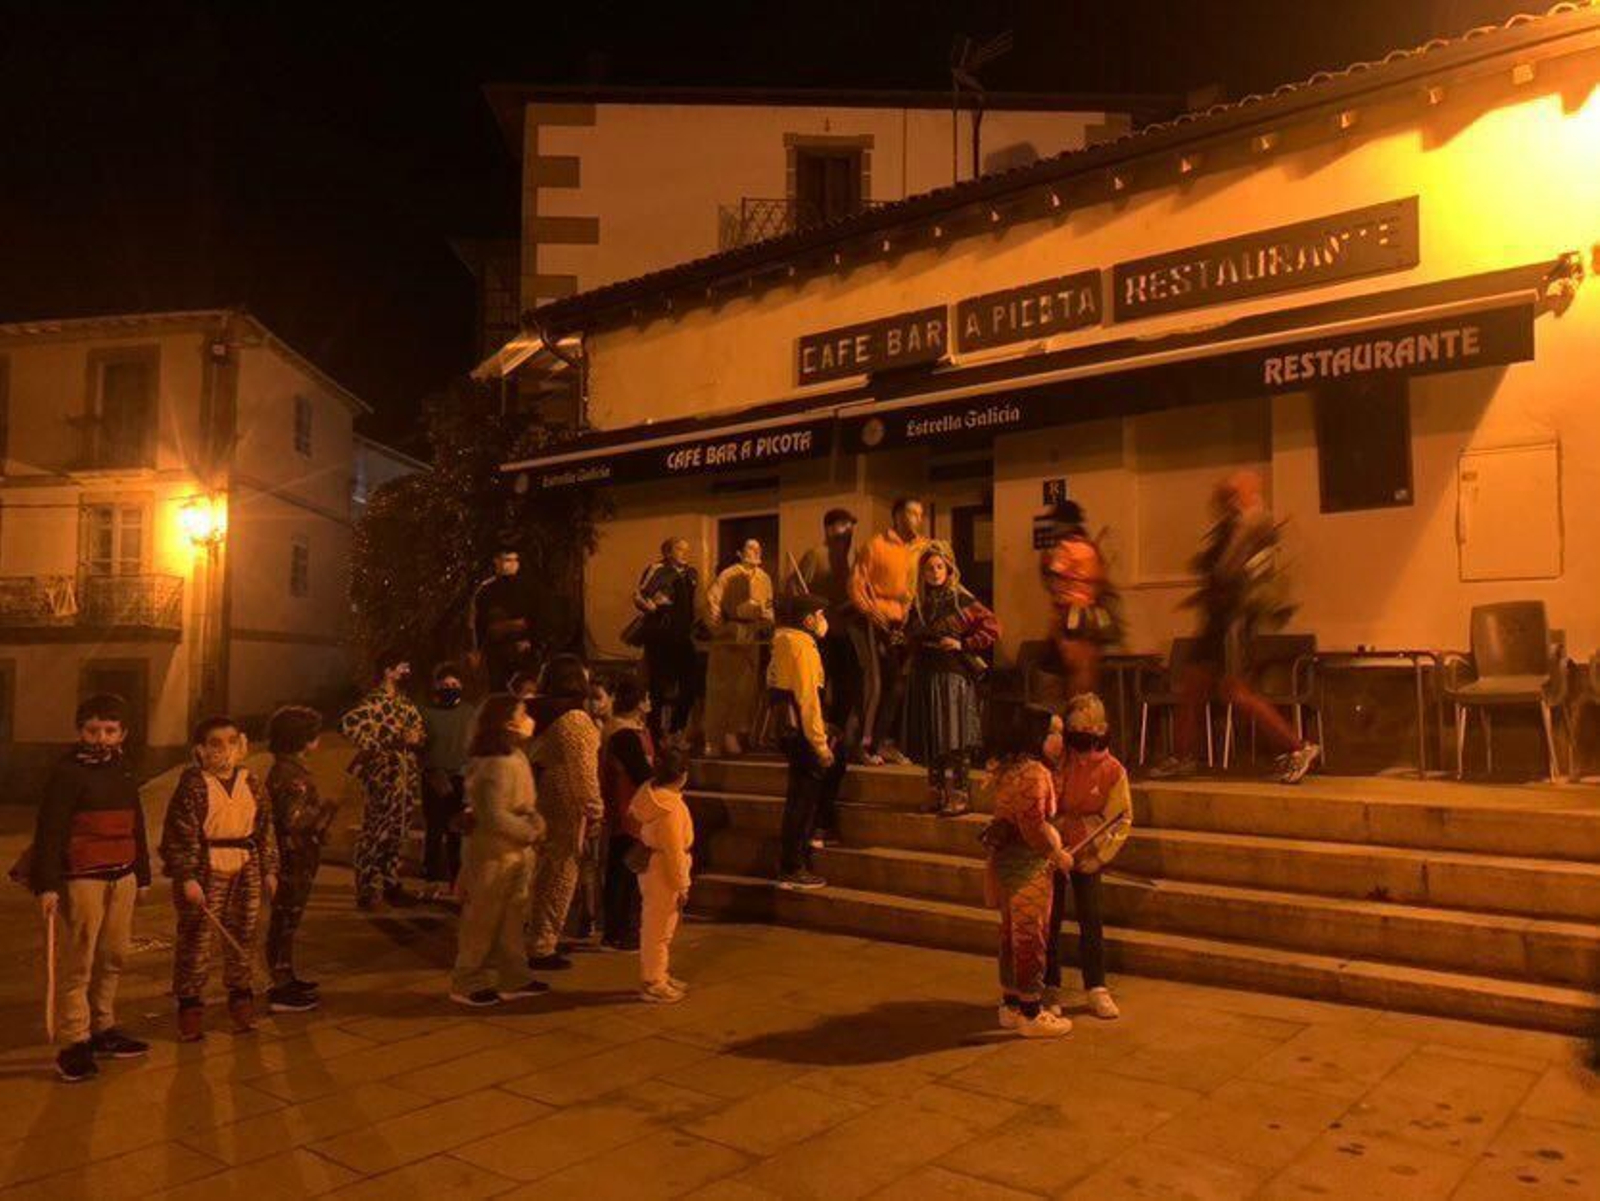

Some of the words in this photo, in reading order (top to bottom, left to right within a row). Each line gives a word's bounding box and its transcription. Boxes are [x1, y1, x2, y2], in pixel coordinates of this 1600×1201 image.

[964, 312, 982, 339] A
[803, 335, 872, 374] CAFE
[888, 319, 942, 356] BAR
[1263, 326, 1481, 386] RESTAURANTE
[907, 415, 963, 437] Estrella
[965, 404, 1021, 430] Galicia
[705, 441, 738, 466] BAR
[740, 439, 754, 462] A
[755, 430, 814, 458] PICOTA
